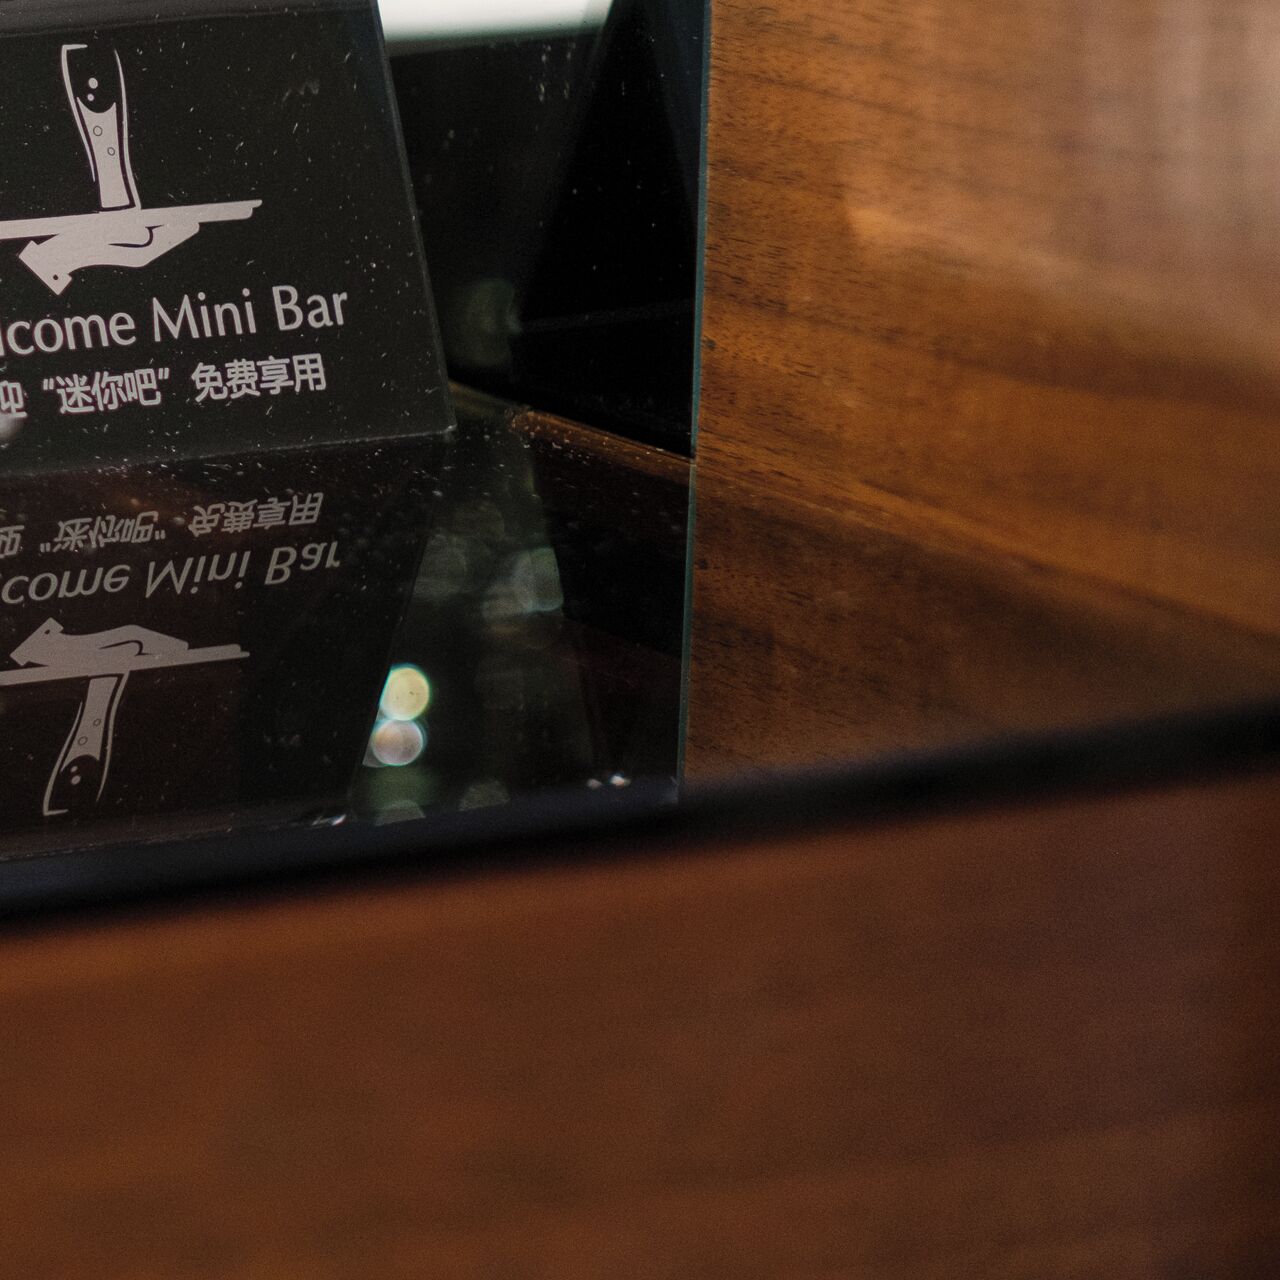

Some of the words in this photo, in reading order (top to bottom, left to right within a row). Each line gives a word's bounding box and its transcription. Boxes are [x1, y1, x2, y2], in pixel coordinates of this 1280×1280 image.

[151, 288, 257, 342] Mini
[271, 285, 348, 330] Bar
[191, 353, 327, 403] 免费享用
